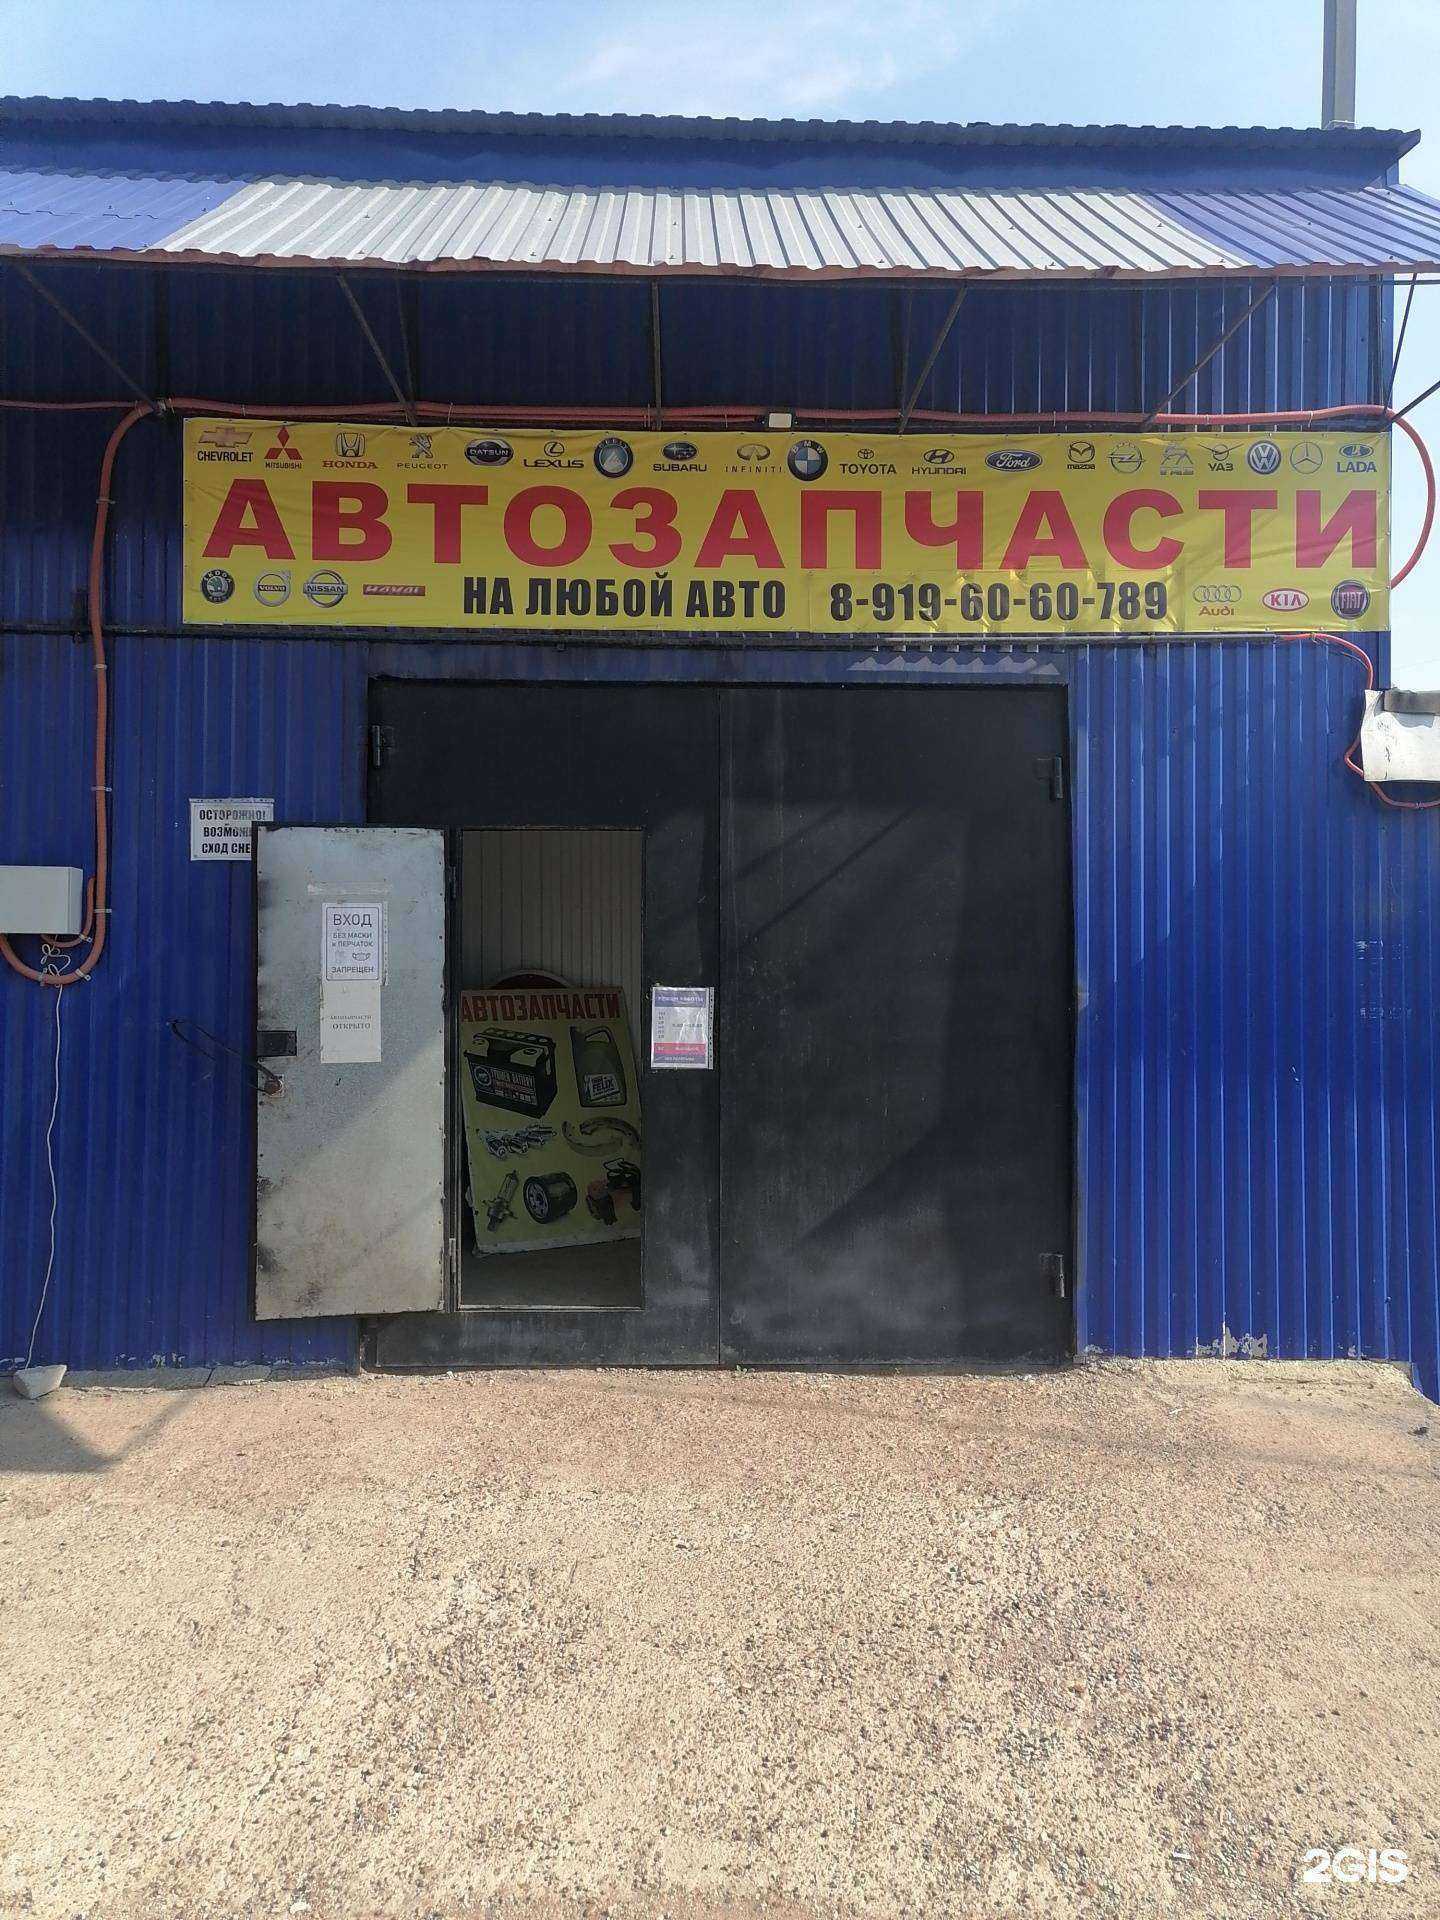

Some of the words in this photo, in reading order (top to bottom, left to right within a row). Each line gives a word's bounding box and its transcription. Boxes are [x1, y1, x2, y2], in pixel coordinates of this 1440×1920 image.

[197, 450, 253, 462] CHEVROLET
[469, 448, 509, 456] DATSUN
[265, 461, 302, 470] MITSUBISHI
[322, 460, 378, 470] HONDA
[397, 462, 448, 470] PEUGEOT
[523, 459, 584, 469] LEXUS
[996, 453, 1032, 470] Ford
[1336, 461, 1377, 473] LADA
[653, 464, 707, 472] SUBARU
[839, 464, 897, 475] TOYOTA
[911, 466, 967, 475] HYUNDAI
[202, 478, 1378, 570] АВТОЗАПЧАСТИ
[259, 583, 287, 592] VOLVO
[307, 585, 344, 593] NISSAN
[464, 577, 514, 616] НА
[525, 572, 672, 617] ЛЮБОЙ
[685, 580, 786, 618] АВТО
[1341, 590, 1364, 611] FIAT
[830, 582, 1167, 621] 8-919-60-60-789
[1269, 595, 1303, 607] KIA
[1199, 605, 1235, 616] Audi
[199, 809, 266, 820] ОСТОРОЖНО!
[203, 826, 251, 837] ВОЗМОЖ
[201, 842, 228, 854] СХОД
[231, 842, 251, 853] СНЕ
[333, 913, 372, 927] ВХОД
[461, 992, 621, 1022] АВТОЗАПЧАСТИ
